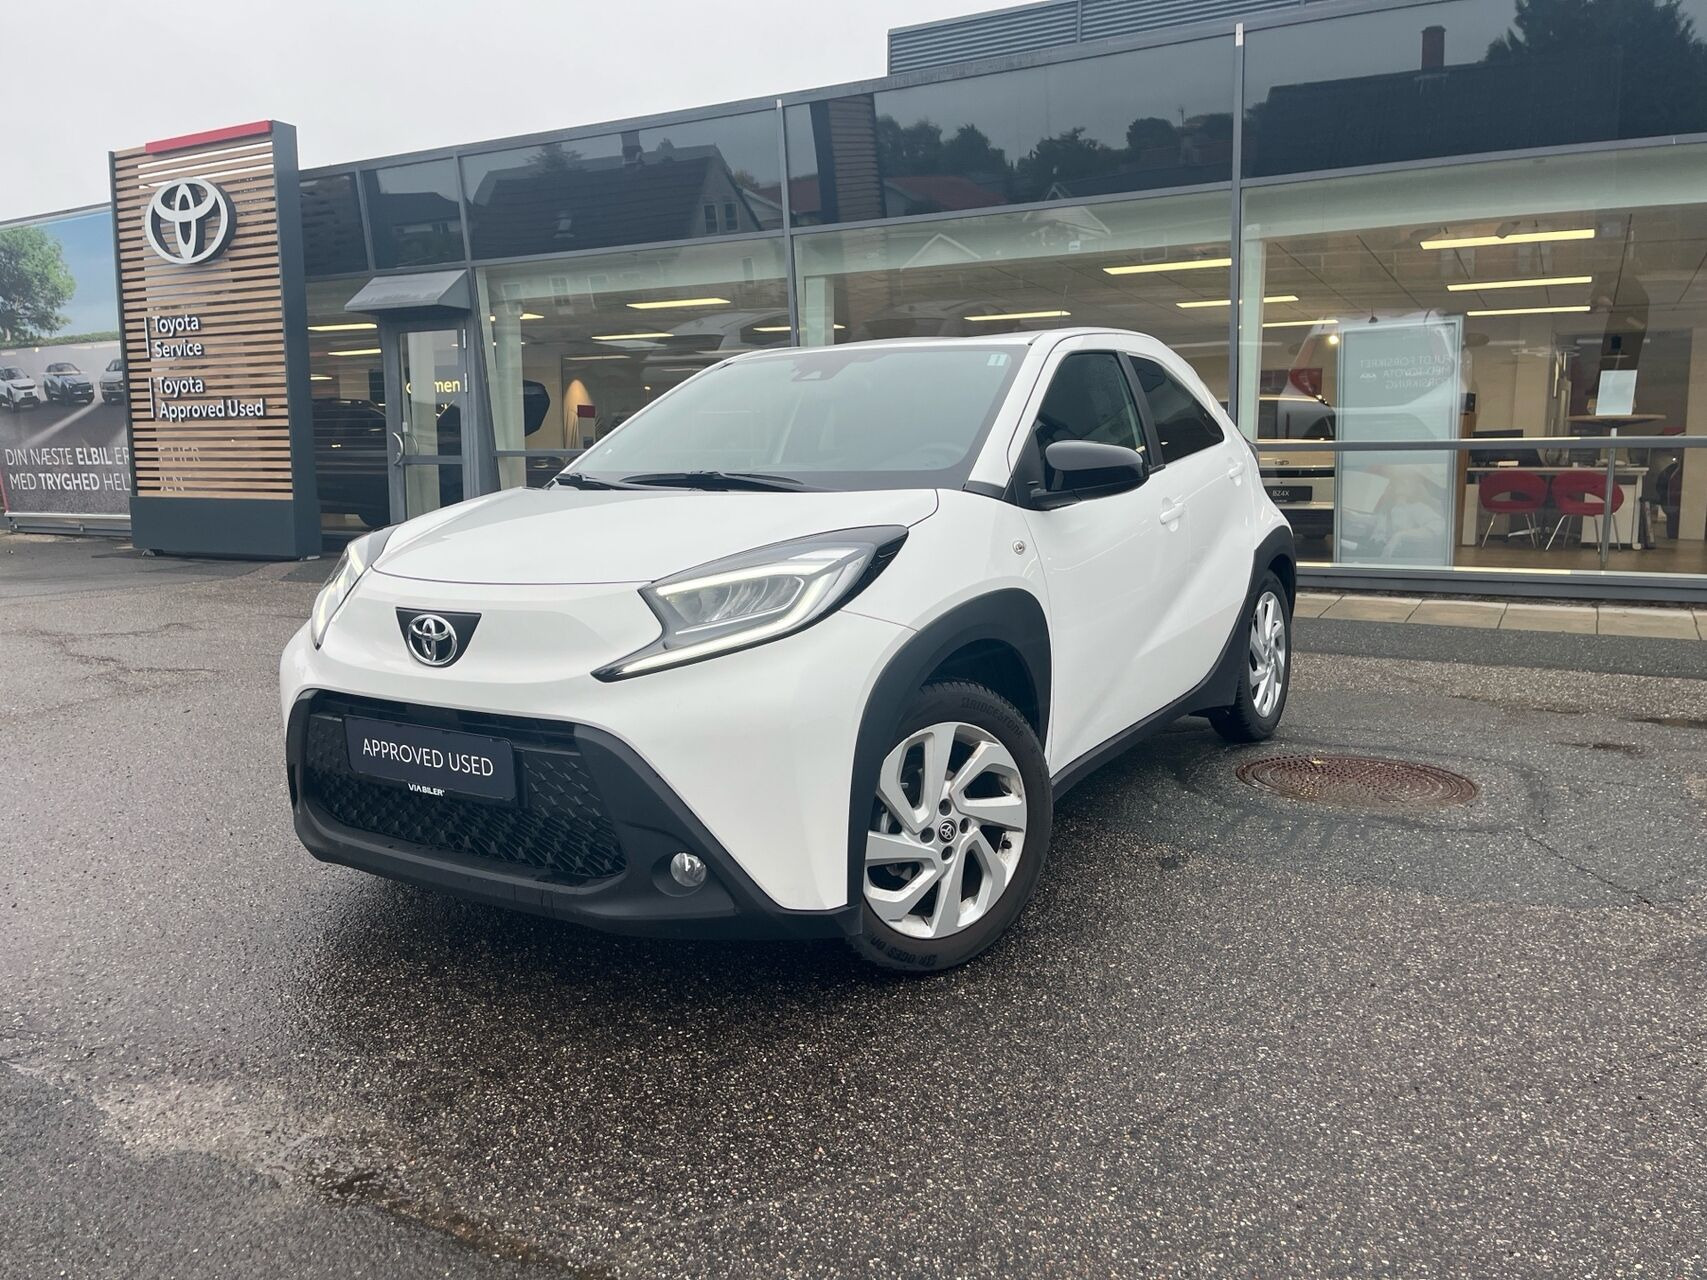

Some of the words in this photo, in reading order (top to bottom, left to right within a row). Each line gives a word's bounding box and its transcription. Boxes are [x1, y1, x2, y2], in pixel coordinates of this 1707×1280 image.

[152, 315, 200, 337] Toyota
[154, 339, 203, 358] Service
[157, 376, 205, 398] Toyota
[160, 399, 226, 423] Approved
[228, 397, 265, 416] Used
[6, 448, 28, 466] DIN
[31, 447, 74, 465] NÆSTE
[76, 447, 113, 465] ELBIL
[9, 473, 37, 491] MED
[38, 473, 101, 491] TRYGHED
[363, 737, 444, 769] APPROVED
[448, 751, 494, 777] USED
